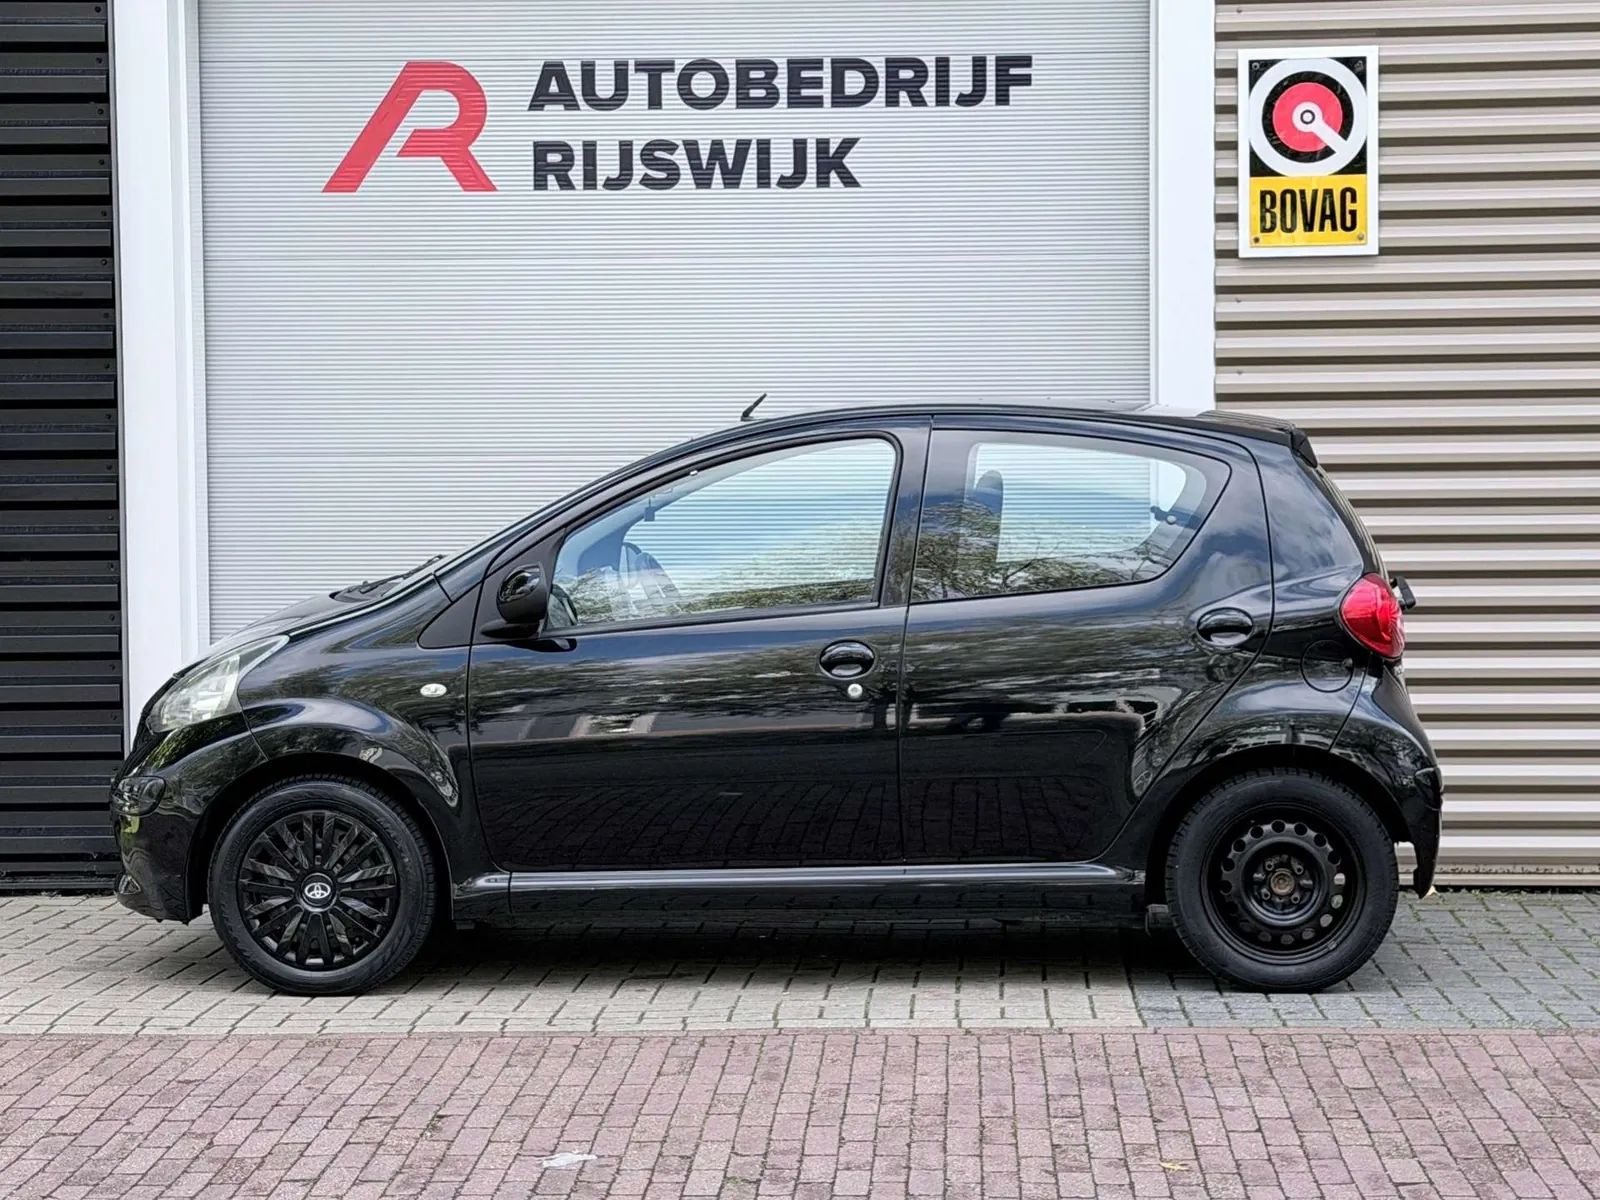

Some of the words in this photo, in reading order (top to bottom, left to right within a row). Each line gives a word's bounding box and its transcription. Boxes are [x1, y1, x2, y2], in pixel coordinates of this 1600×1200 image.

[529, 55, 1033, 110] AUTOBEDRIJF
[533, 138, 861, 191] RIJSWIJK
[1259, 187, 1358, 234] BOVAG
